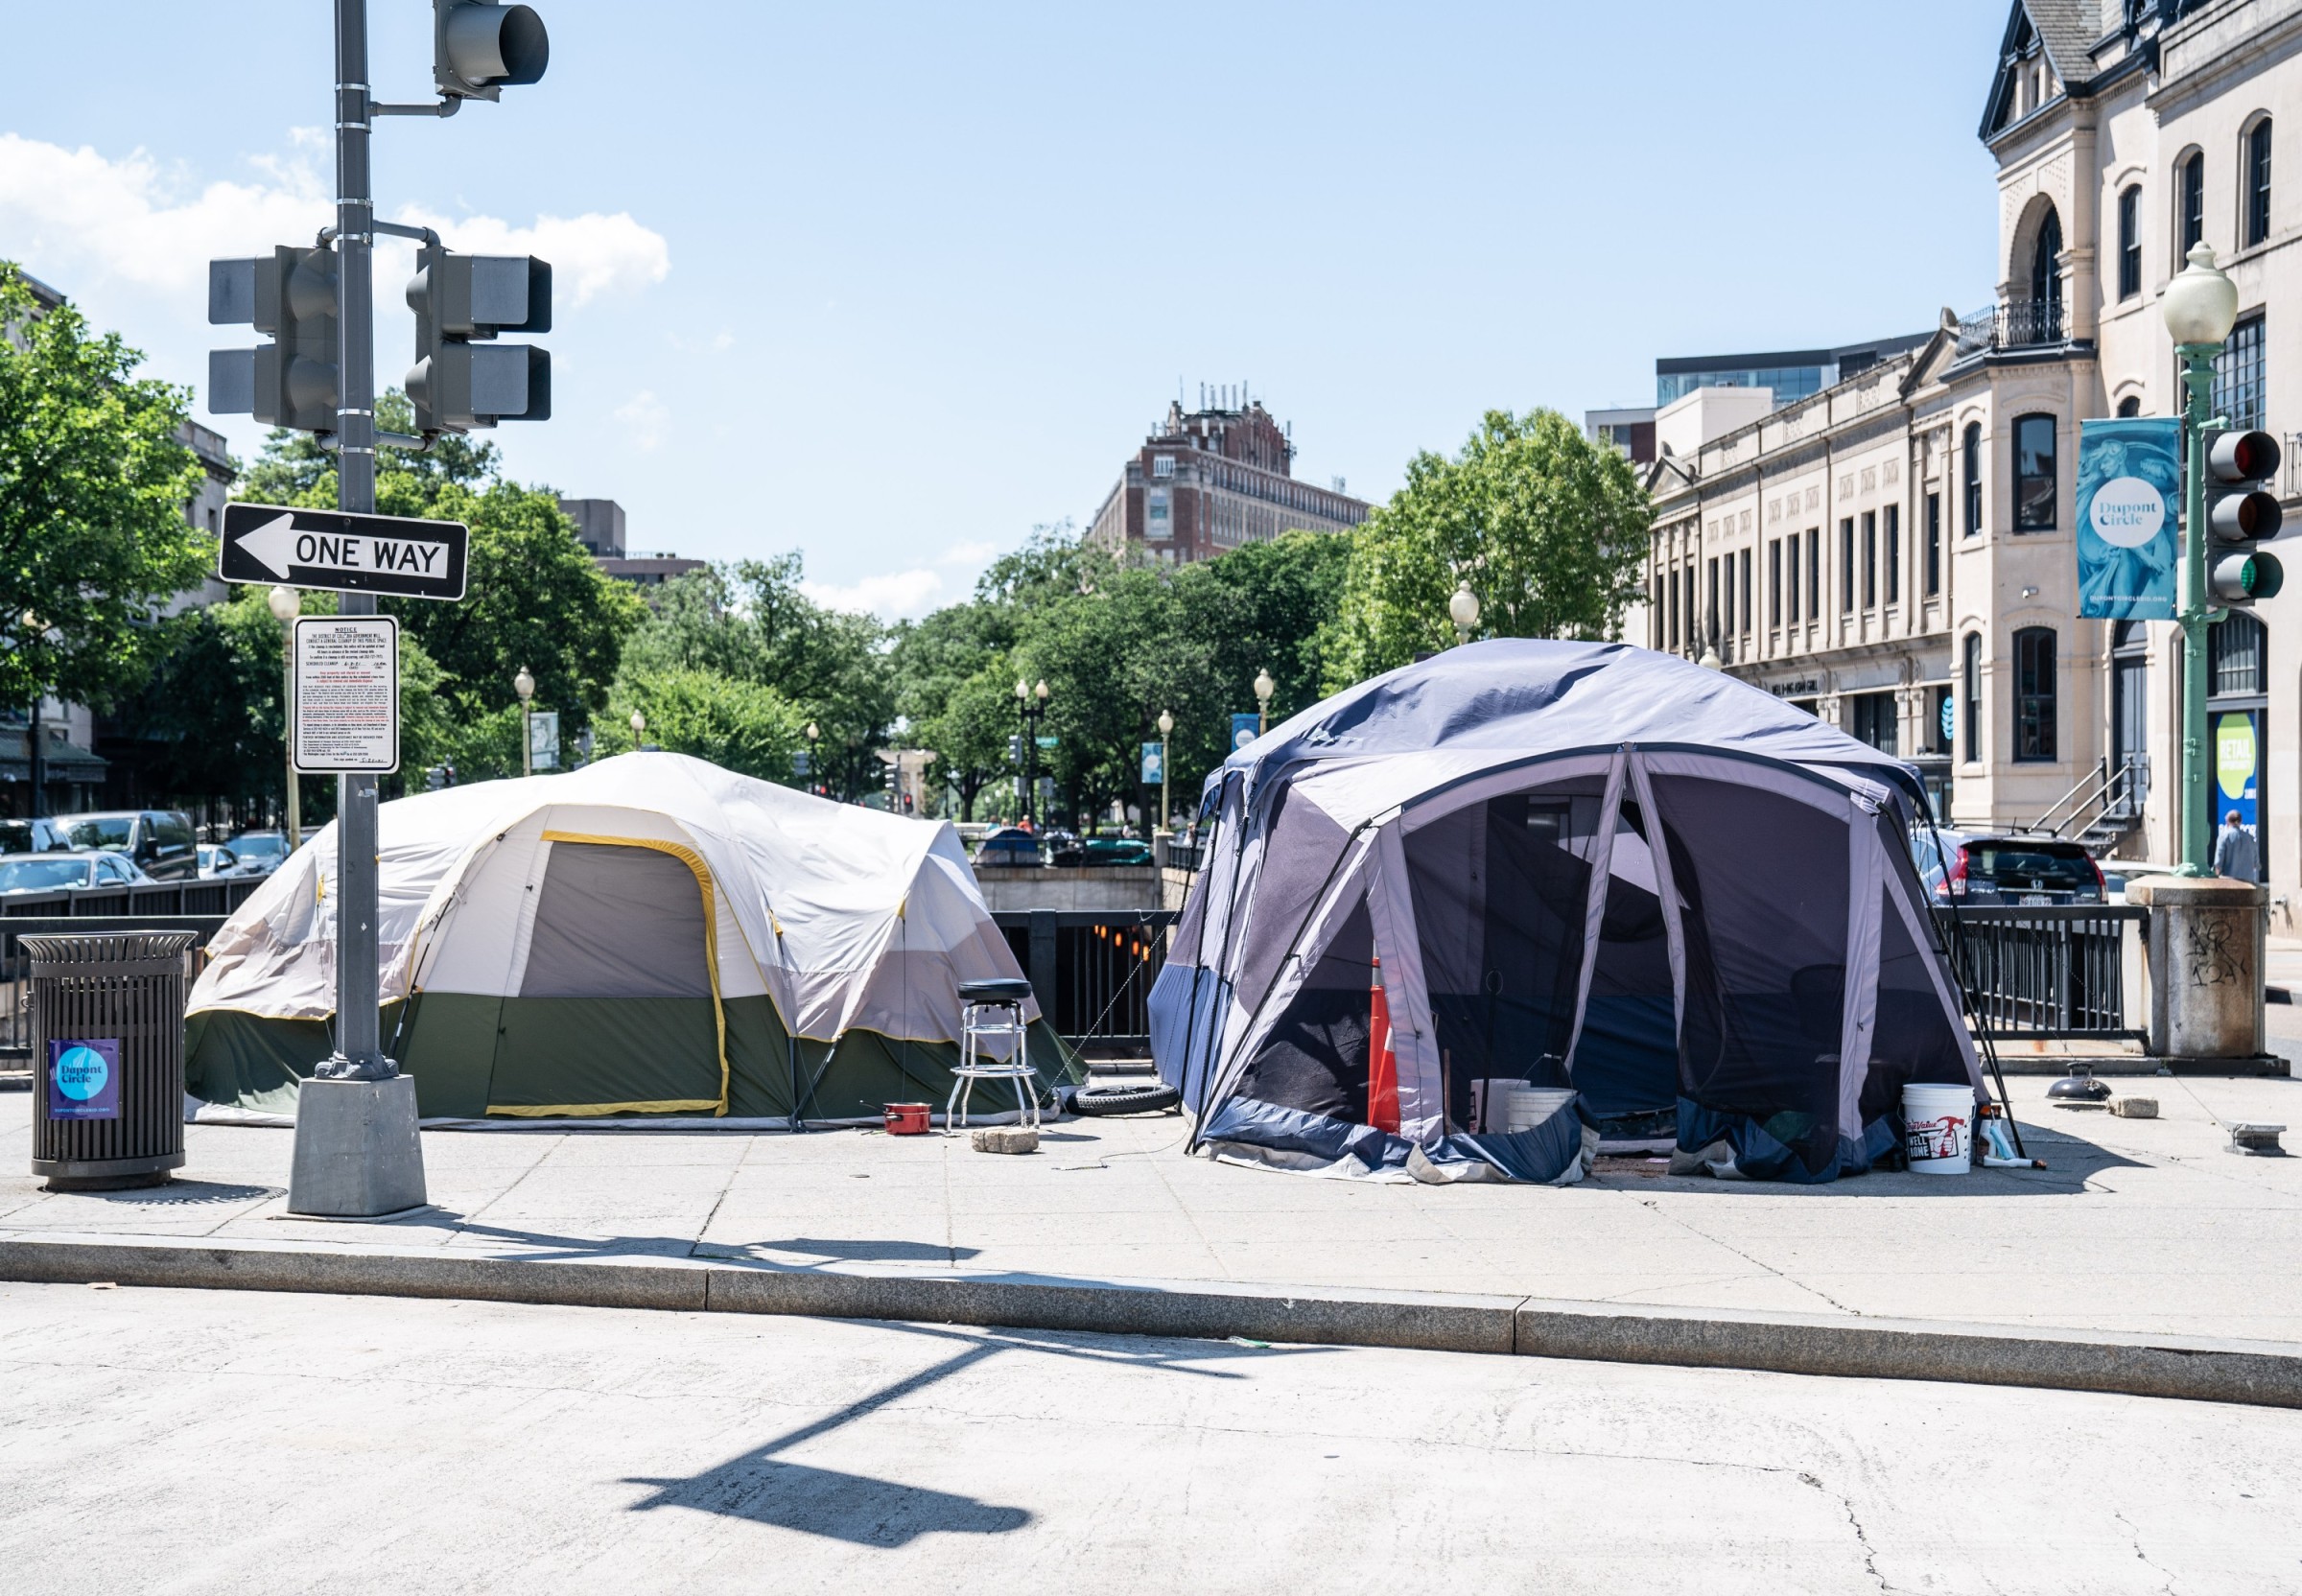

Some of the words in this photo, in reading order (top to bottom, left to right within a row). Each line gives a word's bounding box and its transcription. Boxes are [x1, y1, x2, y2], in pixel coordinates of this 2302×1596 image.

[2100, 503, 2156, 516] Dupont
[2100, 513, 2143, 527] Circle
[295, 534, 361, 567] ONE
[374, 541, 440, 573] WAY
[2220, 739, 2252, 760] RETAIL
[61, 1065, 102, 1077] Dupont
[61, 1073, 92, 1084] Circle
[1909, 1136, 1928, 1146] WELL
